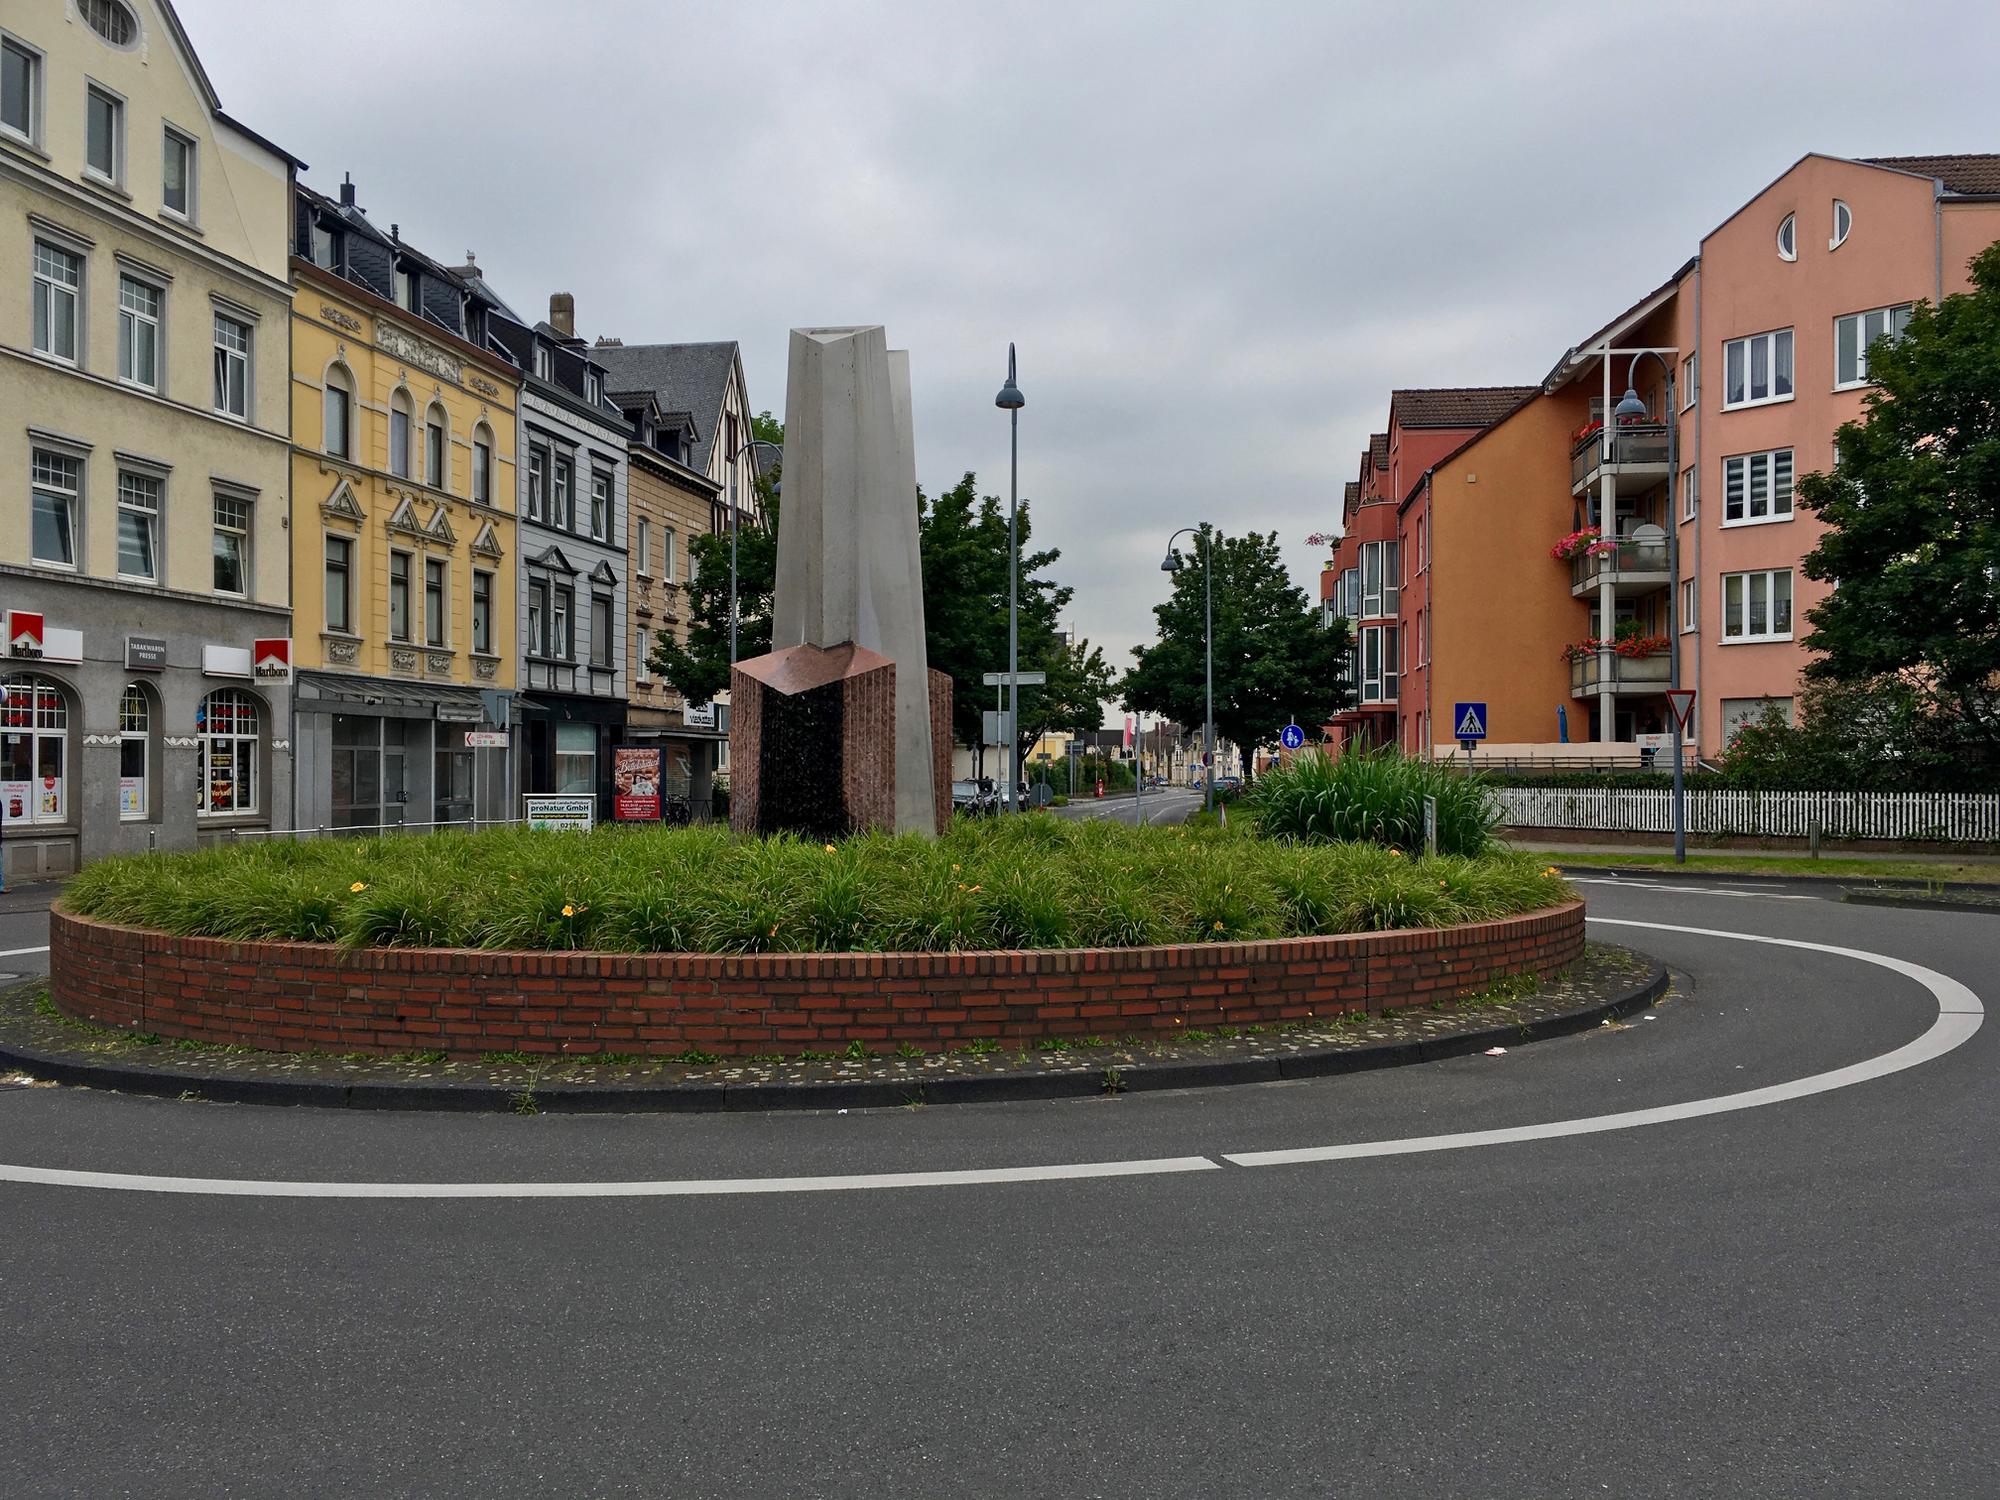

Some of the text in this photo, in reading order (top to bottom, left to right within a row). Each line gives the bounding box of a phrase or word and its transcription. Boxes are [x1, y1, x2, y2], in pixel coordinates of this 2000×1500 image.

[10, 641, 43, 659] Marlboro
[130, 643, 165, 653] TABAKWAREN
[139, 652, 157, 660] PRESSE
[255, 663, 289, 678] Marlboro
